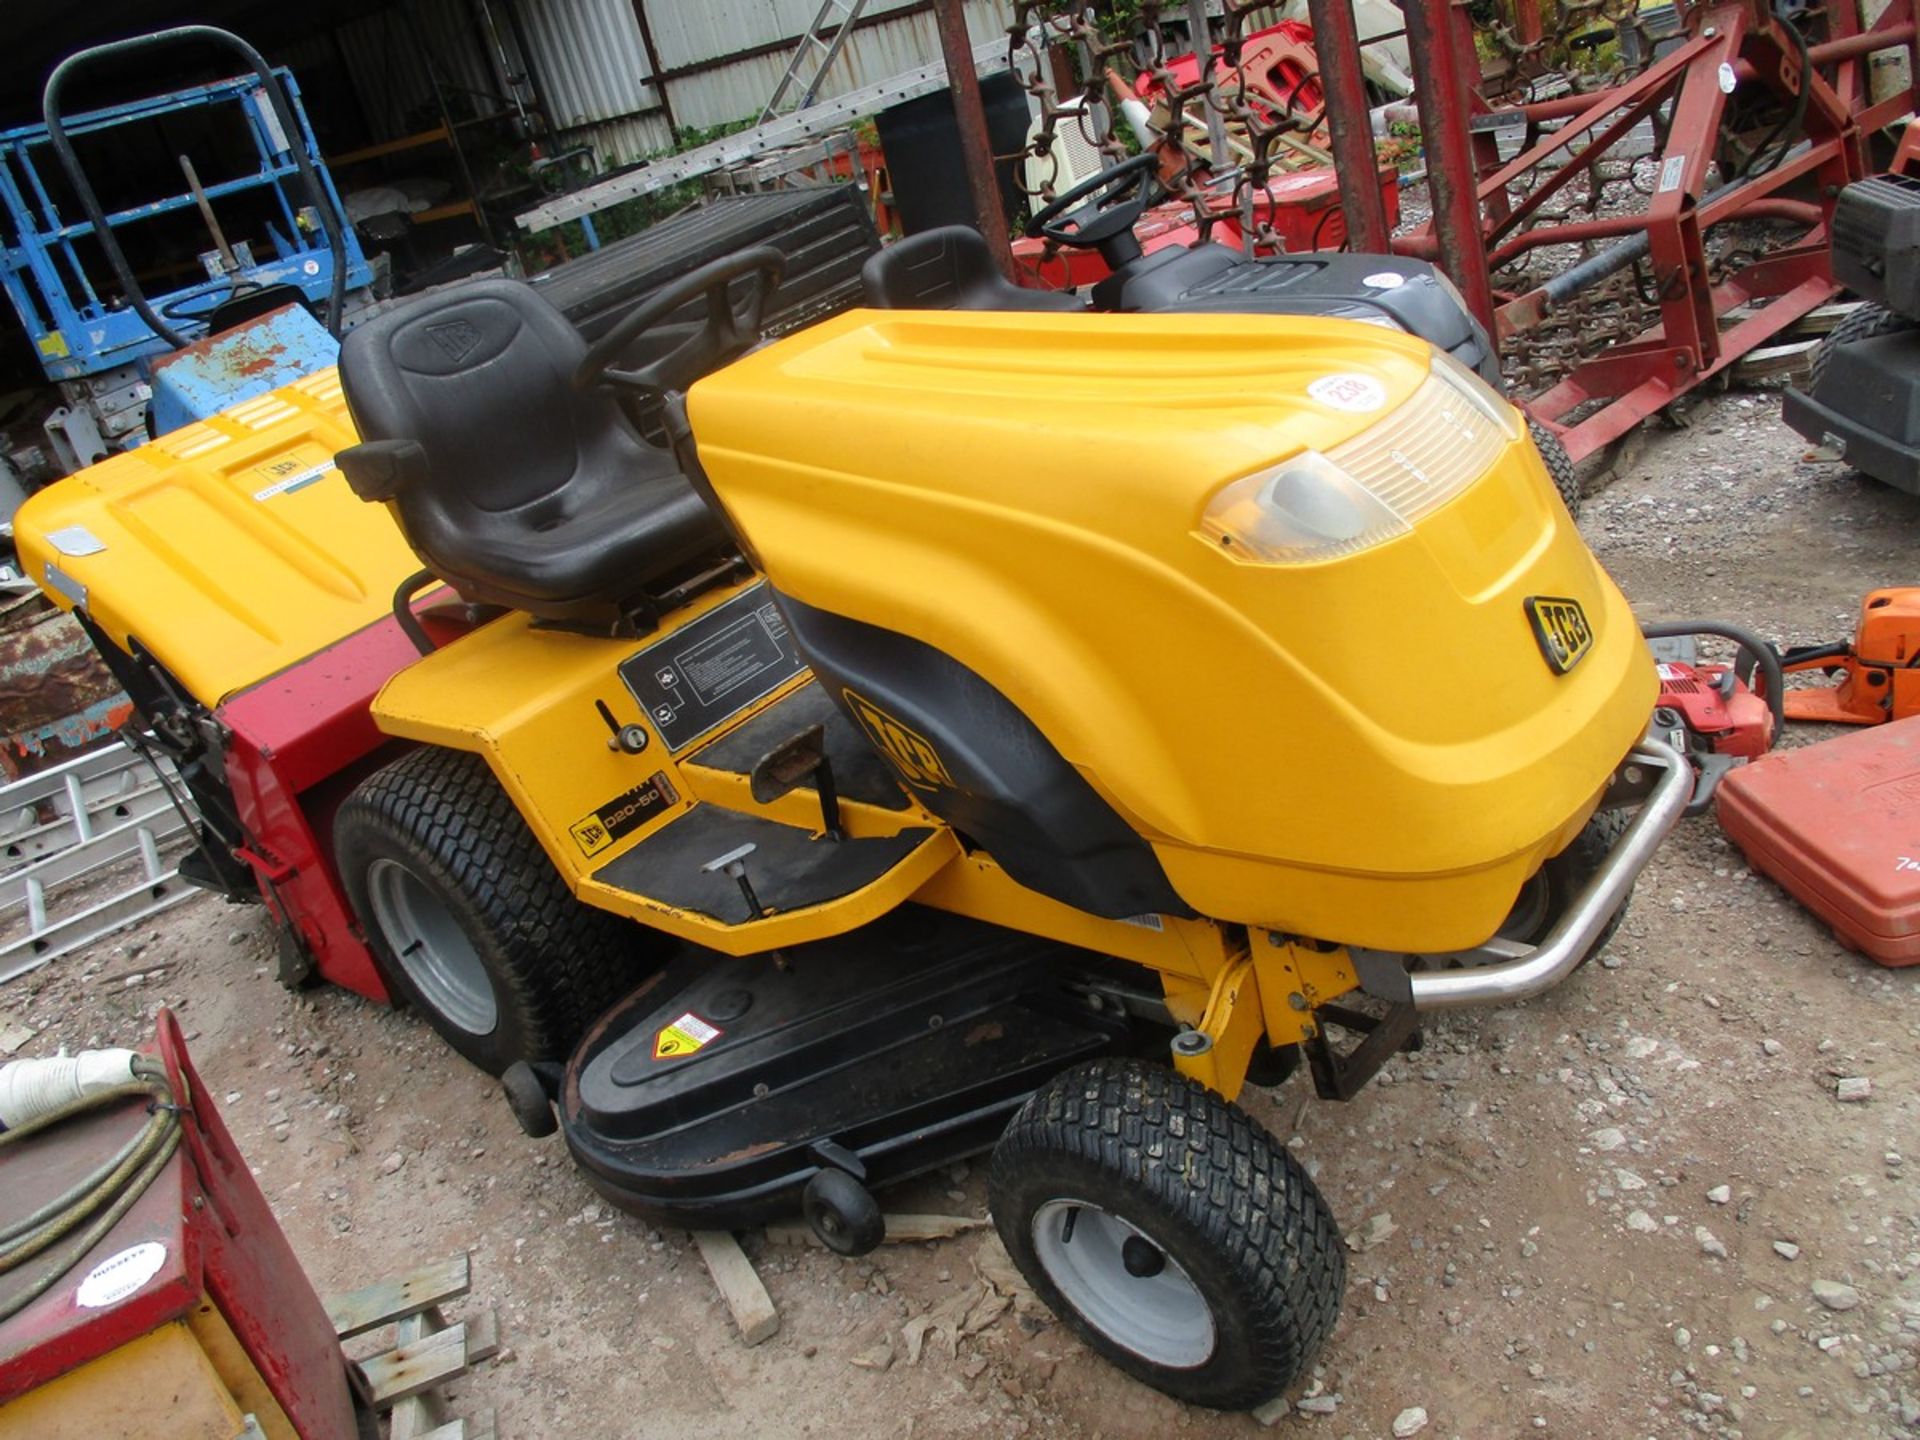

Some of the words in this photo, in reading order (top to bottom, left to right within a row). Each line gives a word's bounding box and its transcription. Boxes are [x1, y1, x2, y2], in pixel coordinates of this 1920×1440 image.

[430, 324, 479, 358] JCB
[270, 461, 297, 476] JCB
[1540, 606, 1587, 663] JCB
[858, 704, 942, 784] JCB
[580, 823, 603, 845] JCB
[604, 788, 660, 829] D20-50
[92, 1248, 146, 1278] HUSSEYS
